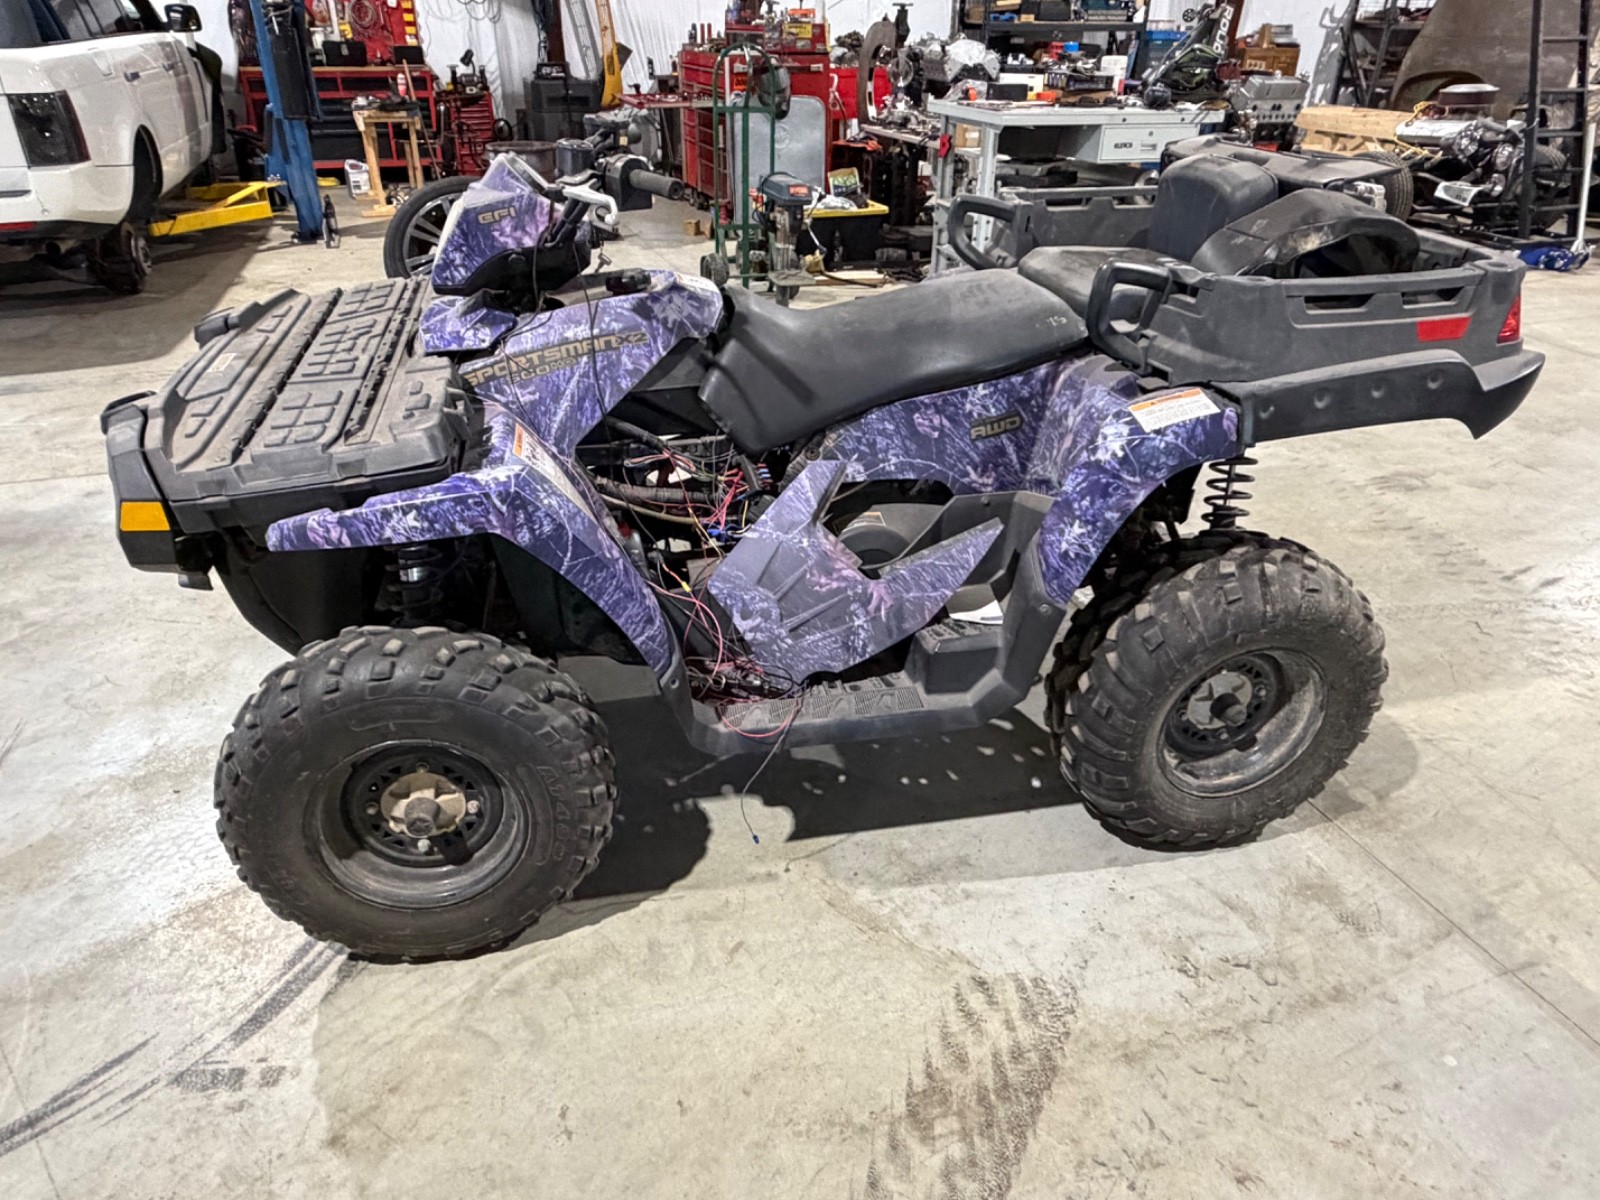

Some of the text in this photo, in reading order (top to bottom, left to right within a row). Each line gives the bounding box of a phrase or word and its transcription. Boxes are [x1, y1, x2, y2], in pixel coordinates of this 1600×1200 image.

[477, 206, 517, 225] EFI
[464, 335, 618, 386] SPORTSMAN
[970, 416, 1021, 439] AWD
